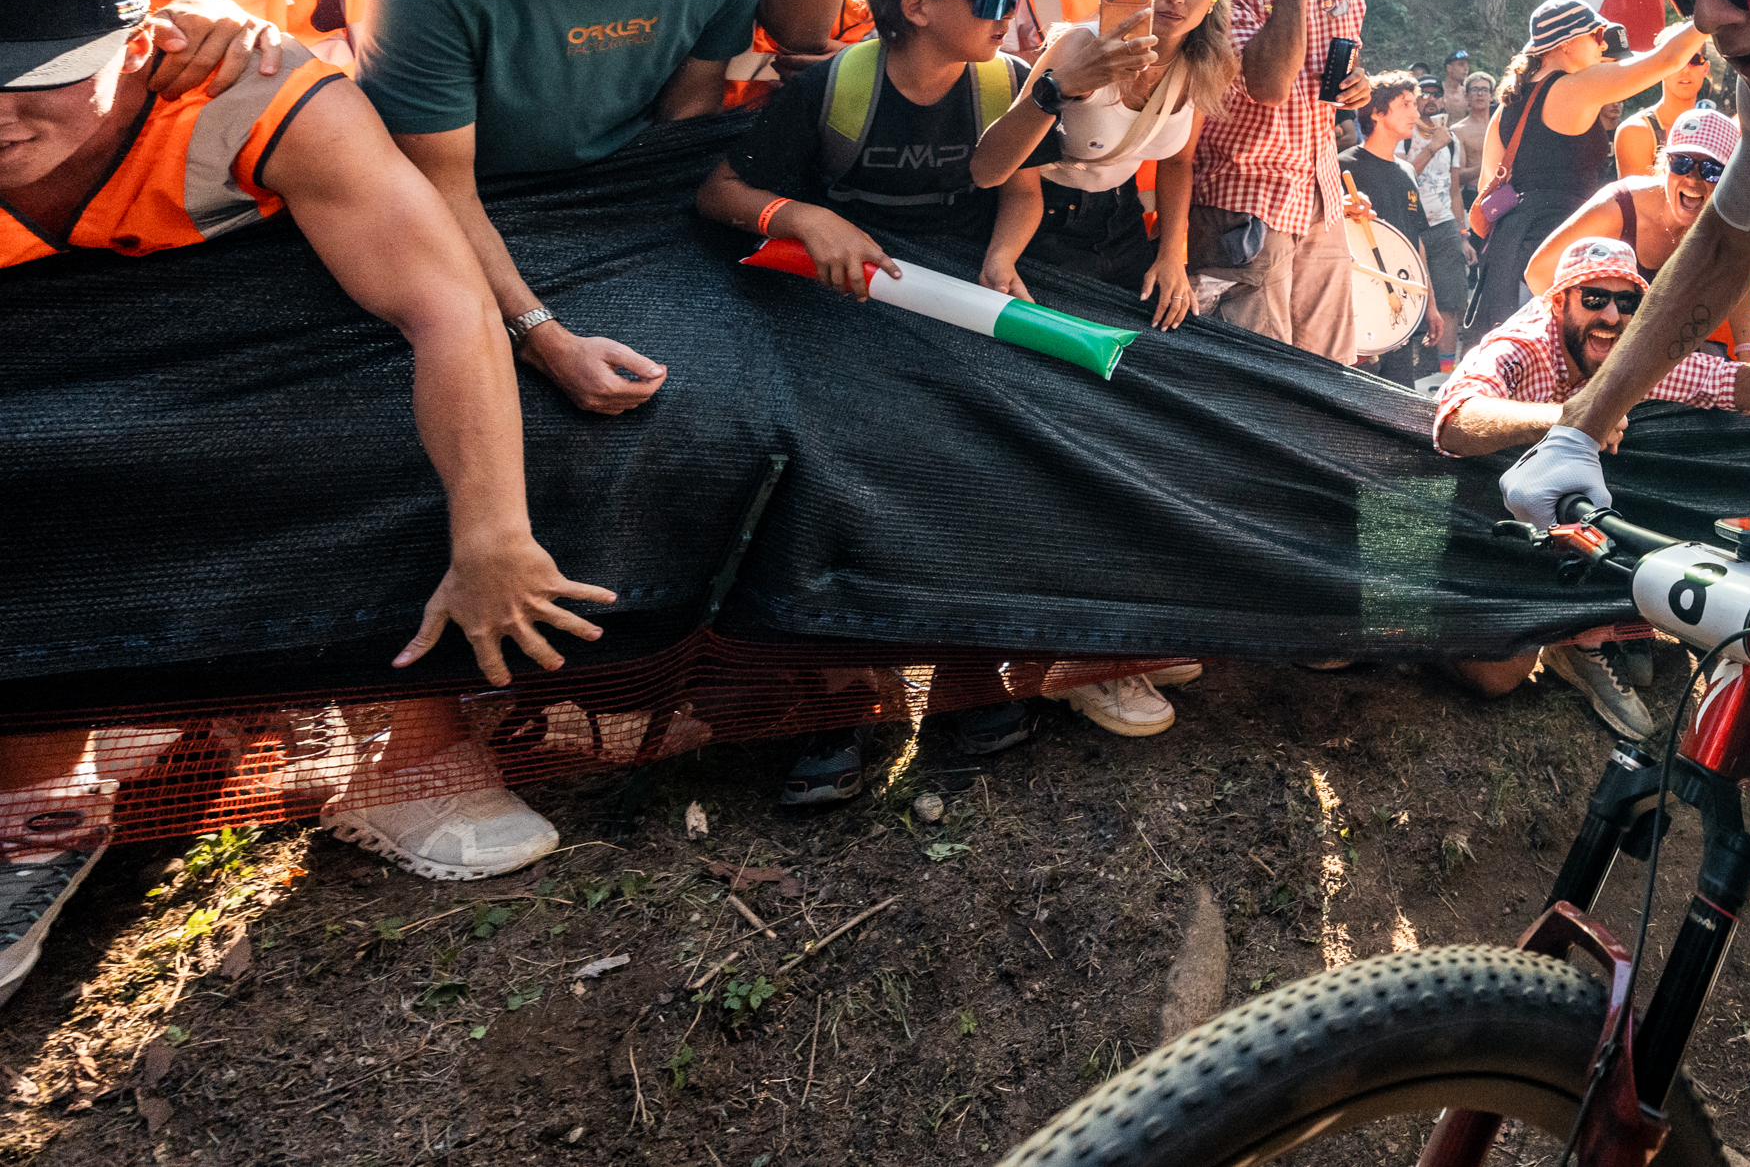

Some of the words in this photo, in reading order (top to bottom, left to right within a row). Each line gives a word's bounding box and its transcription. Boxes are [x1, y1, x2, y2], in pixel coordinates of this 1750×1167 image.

[567, 16, 659, 44] OAKLEY
[862, 144, 970, 170] CMP
[1668, 562, 1727, 625] 8
